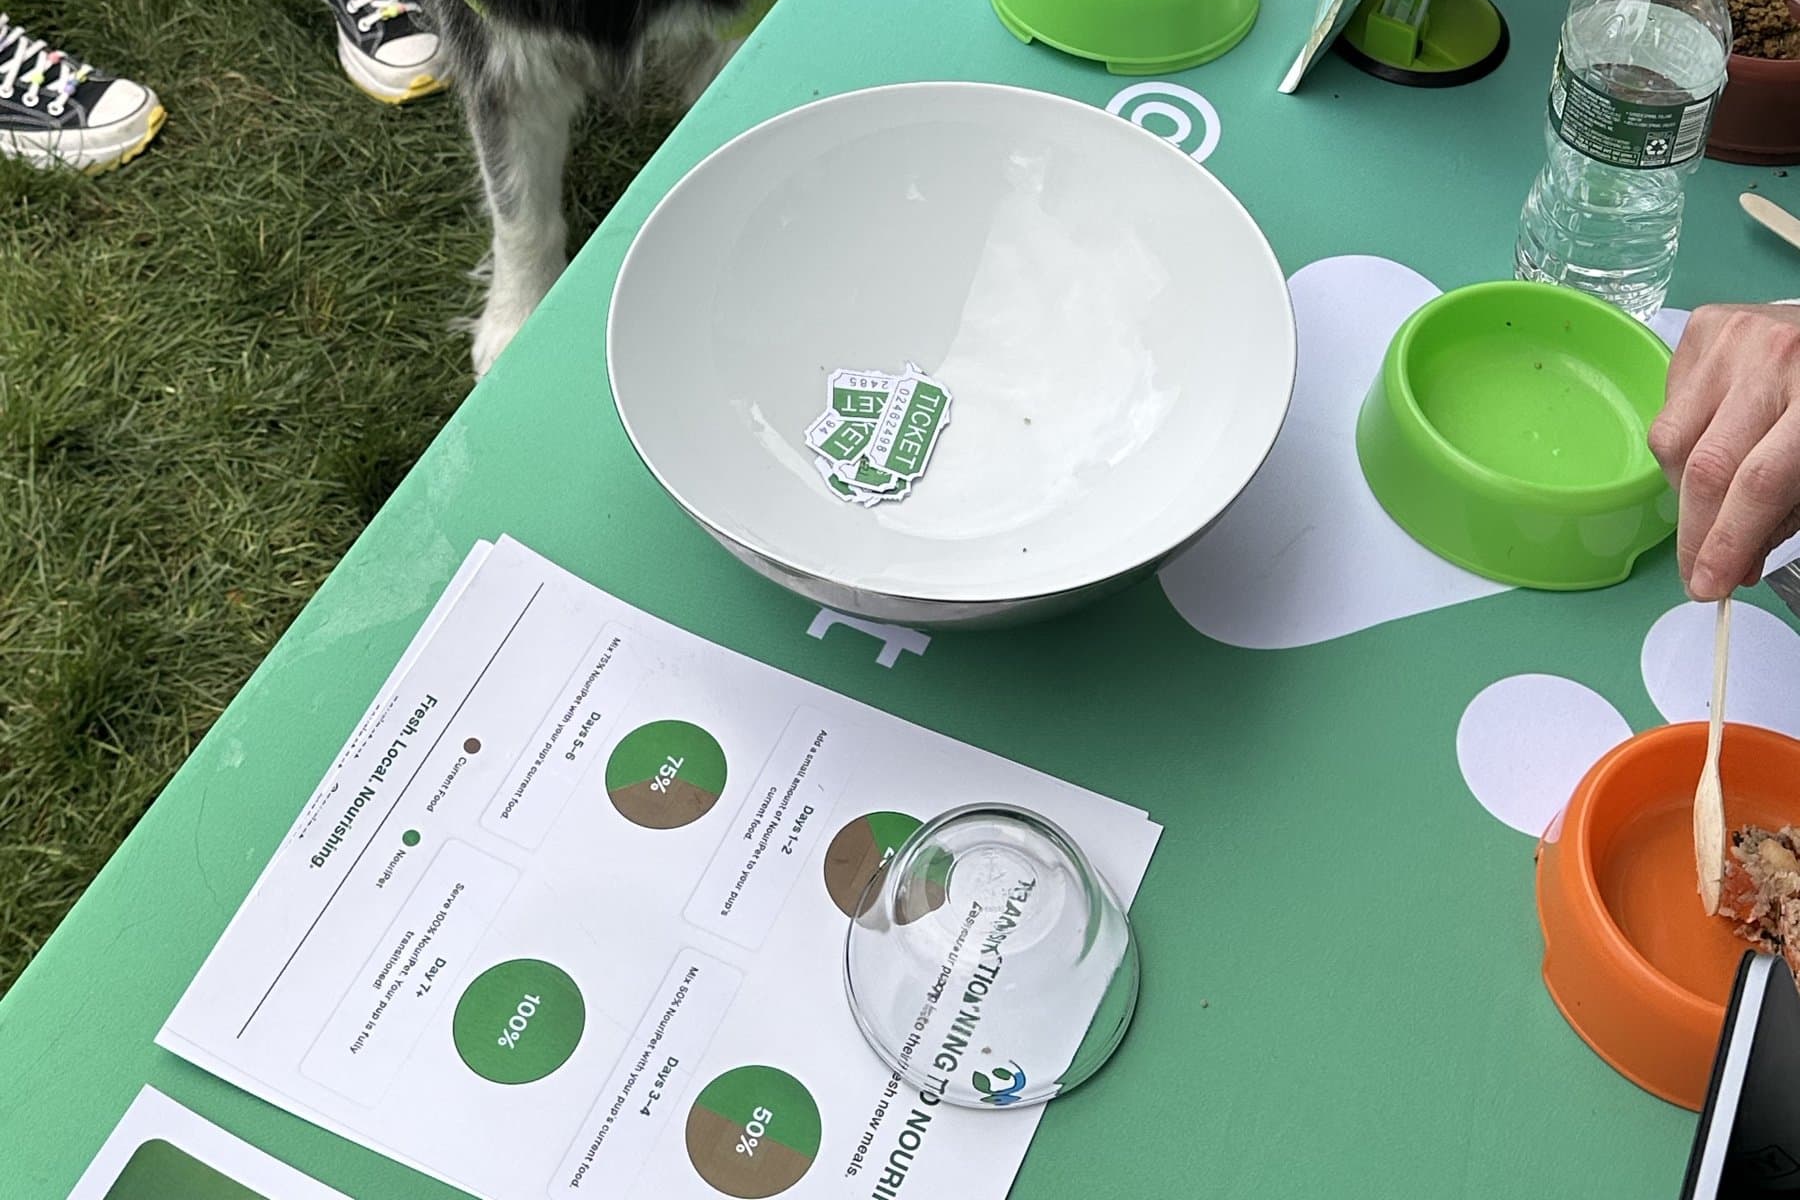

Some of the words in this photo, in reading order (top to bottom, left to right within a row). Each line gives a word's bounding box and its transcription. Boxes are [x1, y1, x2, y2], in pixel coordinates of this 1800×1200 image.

[896, 394, 940, 469] TICKET
[607, 637, 621, 652] Mix
[596, 653, 611, 670] 75%
[574, 670, 600, 705] NouriPet
[400, 694, 438, 736] Fresh.
[562, 705, 577, 723] with
[579, 712, 601, 738] Days
[550, 724, 564, 743] your
[814, 729, 827, 747] Add
[368, 739, 407, 782] Local.
[535, 742, 552, 766] pup's
[797, 754, 813, 778] small
[441, 757, 467, 789] Current
[514, 766, 537, 797] current
[650, 754, 684, 794] 75%
[426, 789, 446, 812] Food
[756, 787, 777, 818] current
[779, 777, 800, 810] amount
[499, 798, 518, 820] food.
[774, 810, 782, 821] of
[792, 805, 814, 833] Days
[310, 786, 376, 868] Nourishing.
[743, 819, 761, 842] food.
[752, 821, 778, 859] NouriPet
[376, 849, 406, 888] NouriPet
[746, 860, 756, 870] to
[735, 870, 750, 890] your
[443, 883, 465, 909] Serve
[721, 891, 738, 916] pup's
[427, 910, 447, 935] 100%
[399, 935, 431, 978] NouriPet.
[424, 957, 447, 982] Day
[684, 967, 699, 984] Mix
[385, 980, 404, 1001] Your
[416, 984, 431, 997] 7+
[671, 985, 688, 1007] 50%
[372, 1000, 387, 1020] pup
[497, 994, 541, 1050] 100%
[365, 1020, 376, 1030] is
[648, 1007, 676, 1050] NouriPet
[350, 1031, 369, 1054] fully
[635, 1051, 651, 1072] with
[654, 1056, 679, 1088] Days
[622, 1073, 638, 1096] your
[606, 1095, 625, 1123] pup's
[869, 1099, 889, 1130] new
[585, 1124, 609, 1162] current
[736, 1105, 773, 1157] 50%
[845, 1131, 874, 1178] meals.
[569, 1163, 590, 1188] food.
